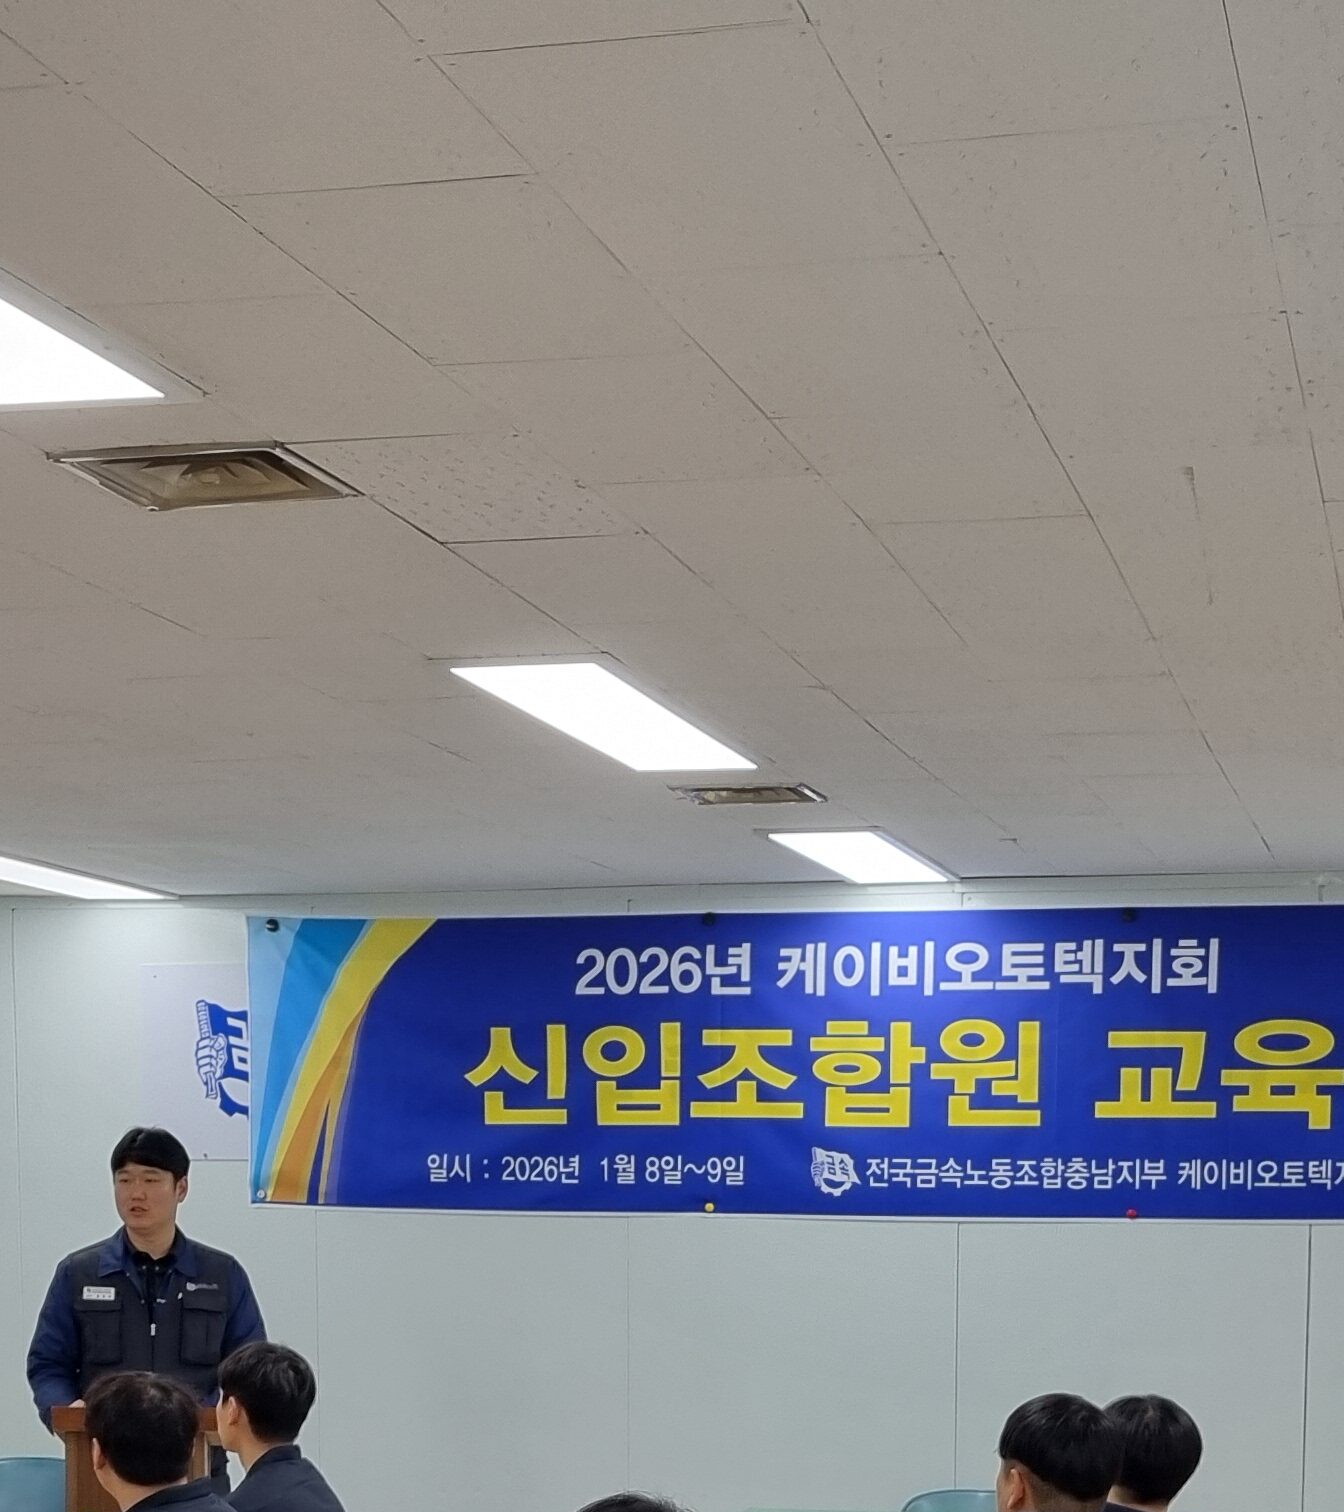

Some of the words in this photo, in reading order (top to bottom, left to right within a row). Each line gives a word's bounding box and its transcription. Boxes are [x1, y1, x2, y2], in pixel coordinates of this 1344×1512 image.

[575, 941, 752, 996] 2026년
[776, 937, 1220, 997] 케이비오토텍지회
[464, 1017, 1043, 1129] 신입조합원
[427, 1152, 472, 1183] 일시
[501, 1154, 581, 1185] 2026년
[599, 1154, 636, 1185] 1월
[865, 1156, 1168, 1191] 전국금속노동조합충남지부
